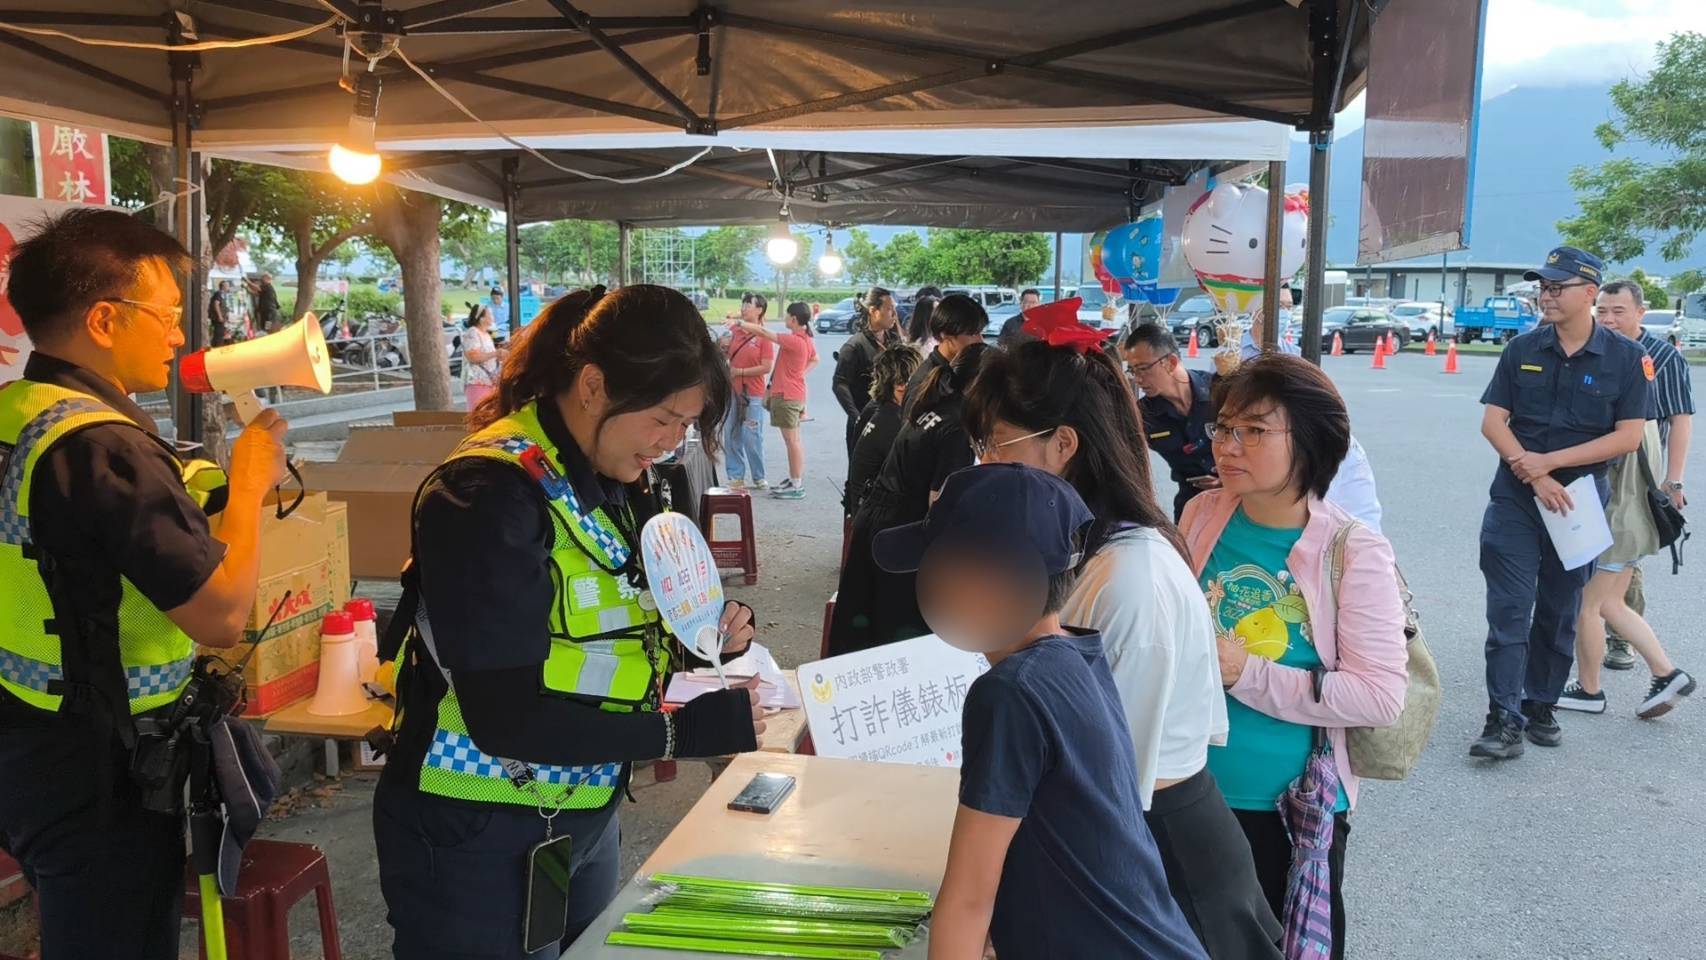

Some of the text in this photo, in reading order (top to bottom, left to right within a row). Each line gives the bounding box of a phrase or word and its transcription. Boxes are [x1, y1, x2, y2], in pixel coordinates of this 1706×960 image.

[829, 673, 967, 746] 打詐儀錶板
[848, 723, 962, 763] 掃描QRcode了解最新打
